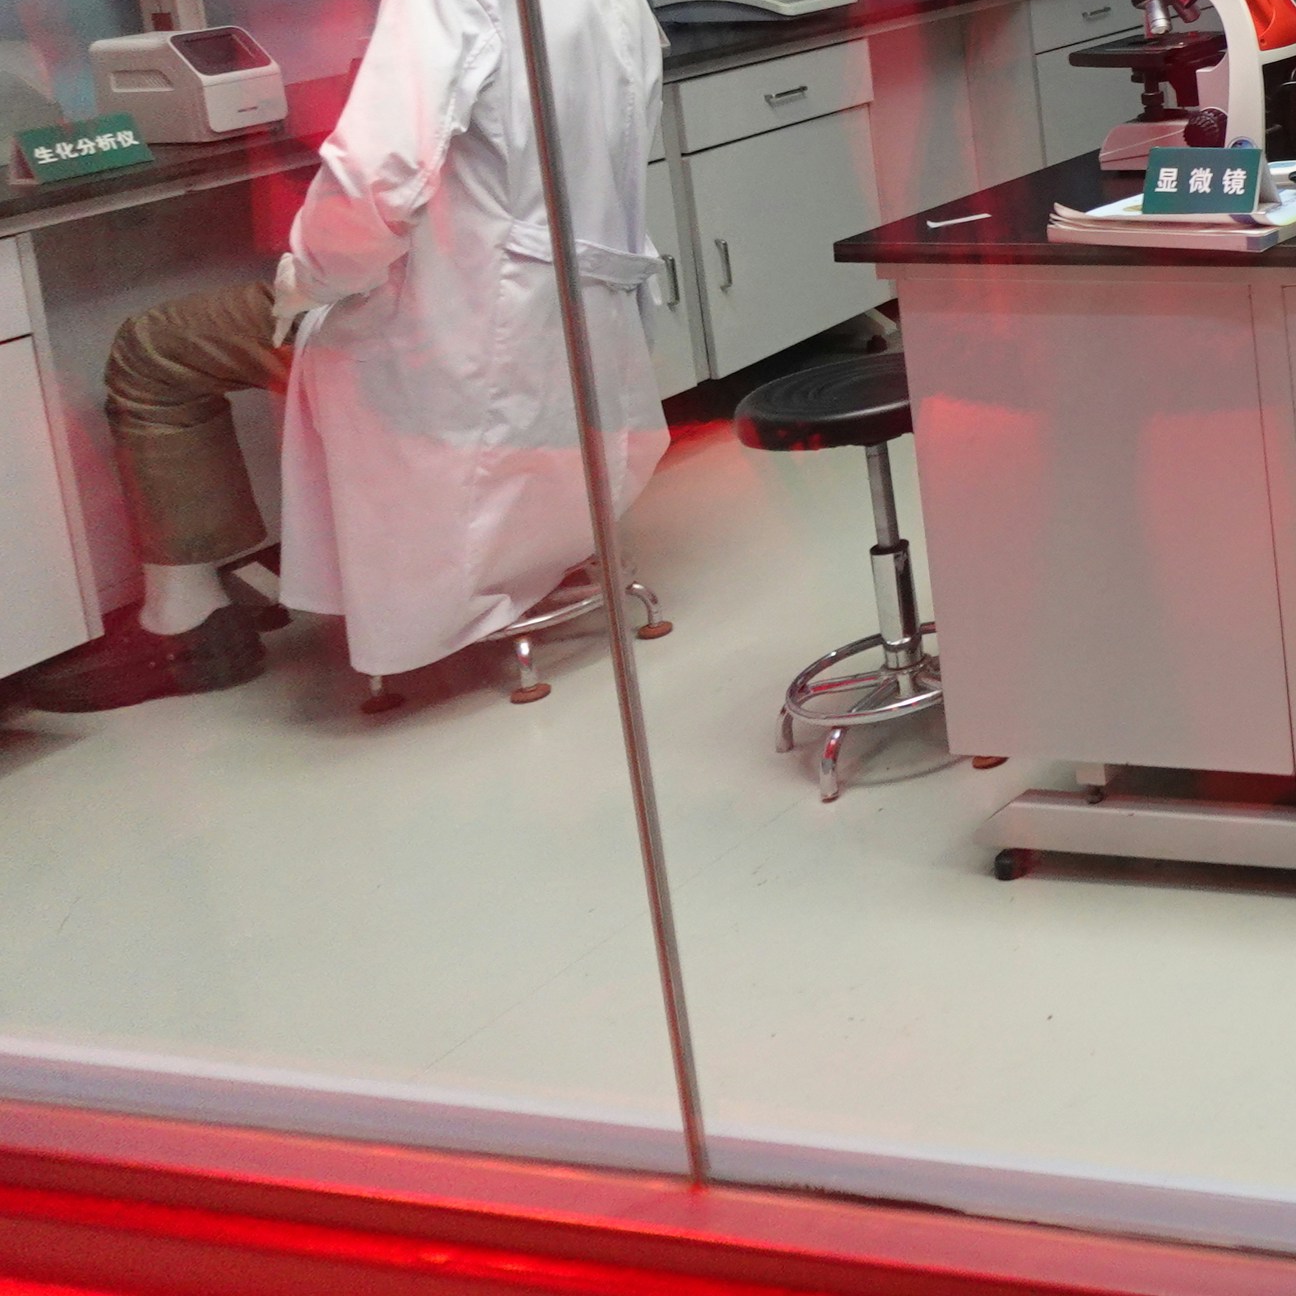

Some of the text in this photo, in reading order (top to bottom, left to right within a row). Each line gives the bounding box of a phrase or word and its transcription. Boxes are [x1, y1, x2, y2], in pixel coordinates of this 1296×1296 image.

[34, 130, 139, 164] 生化分析仪
[1154, 167, 1247, 195] 显微镜
